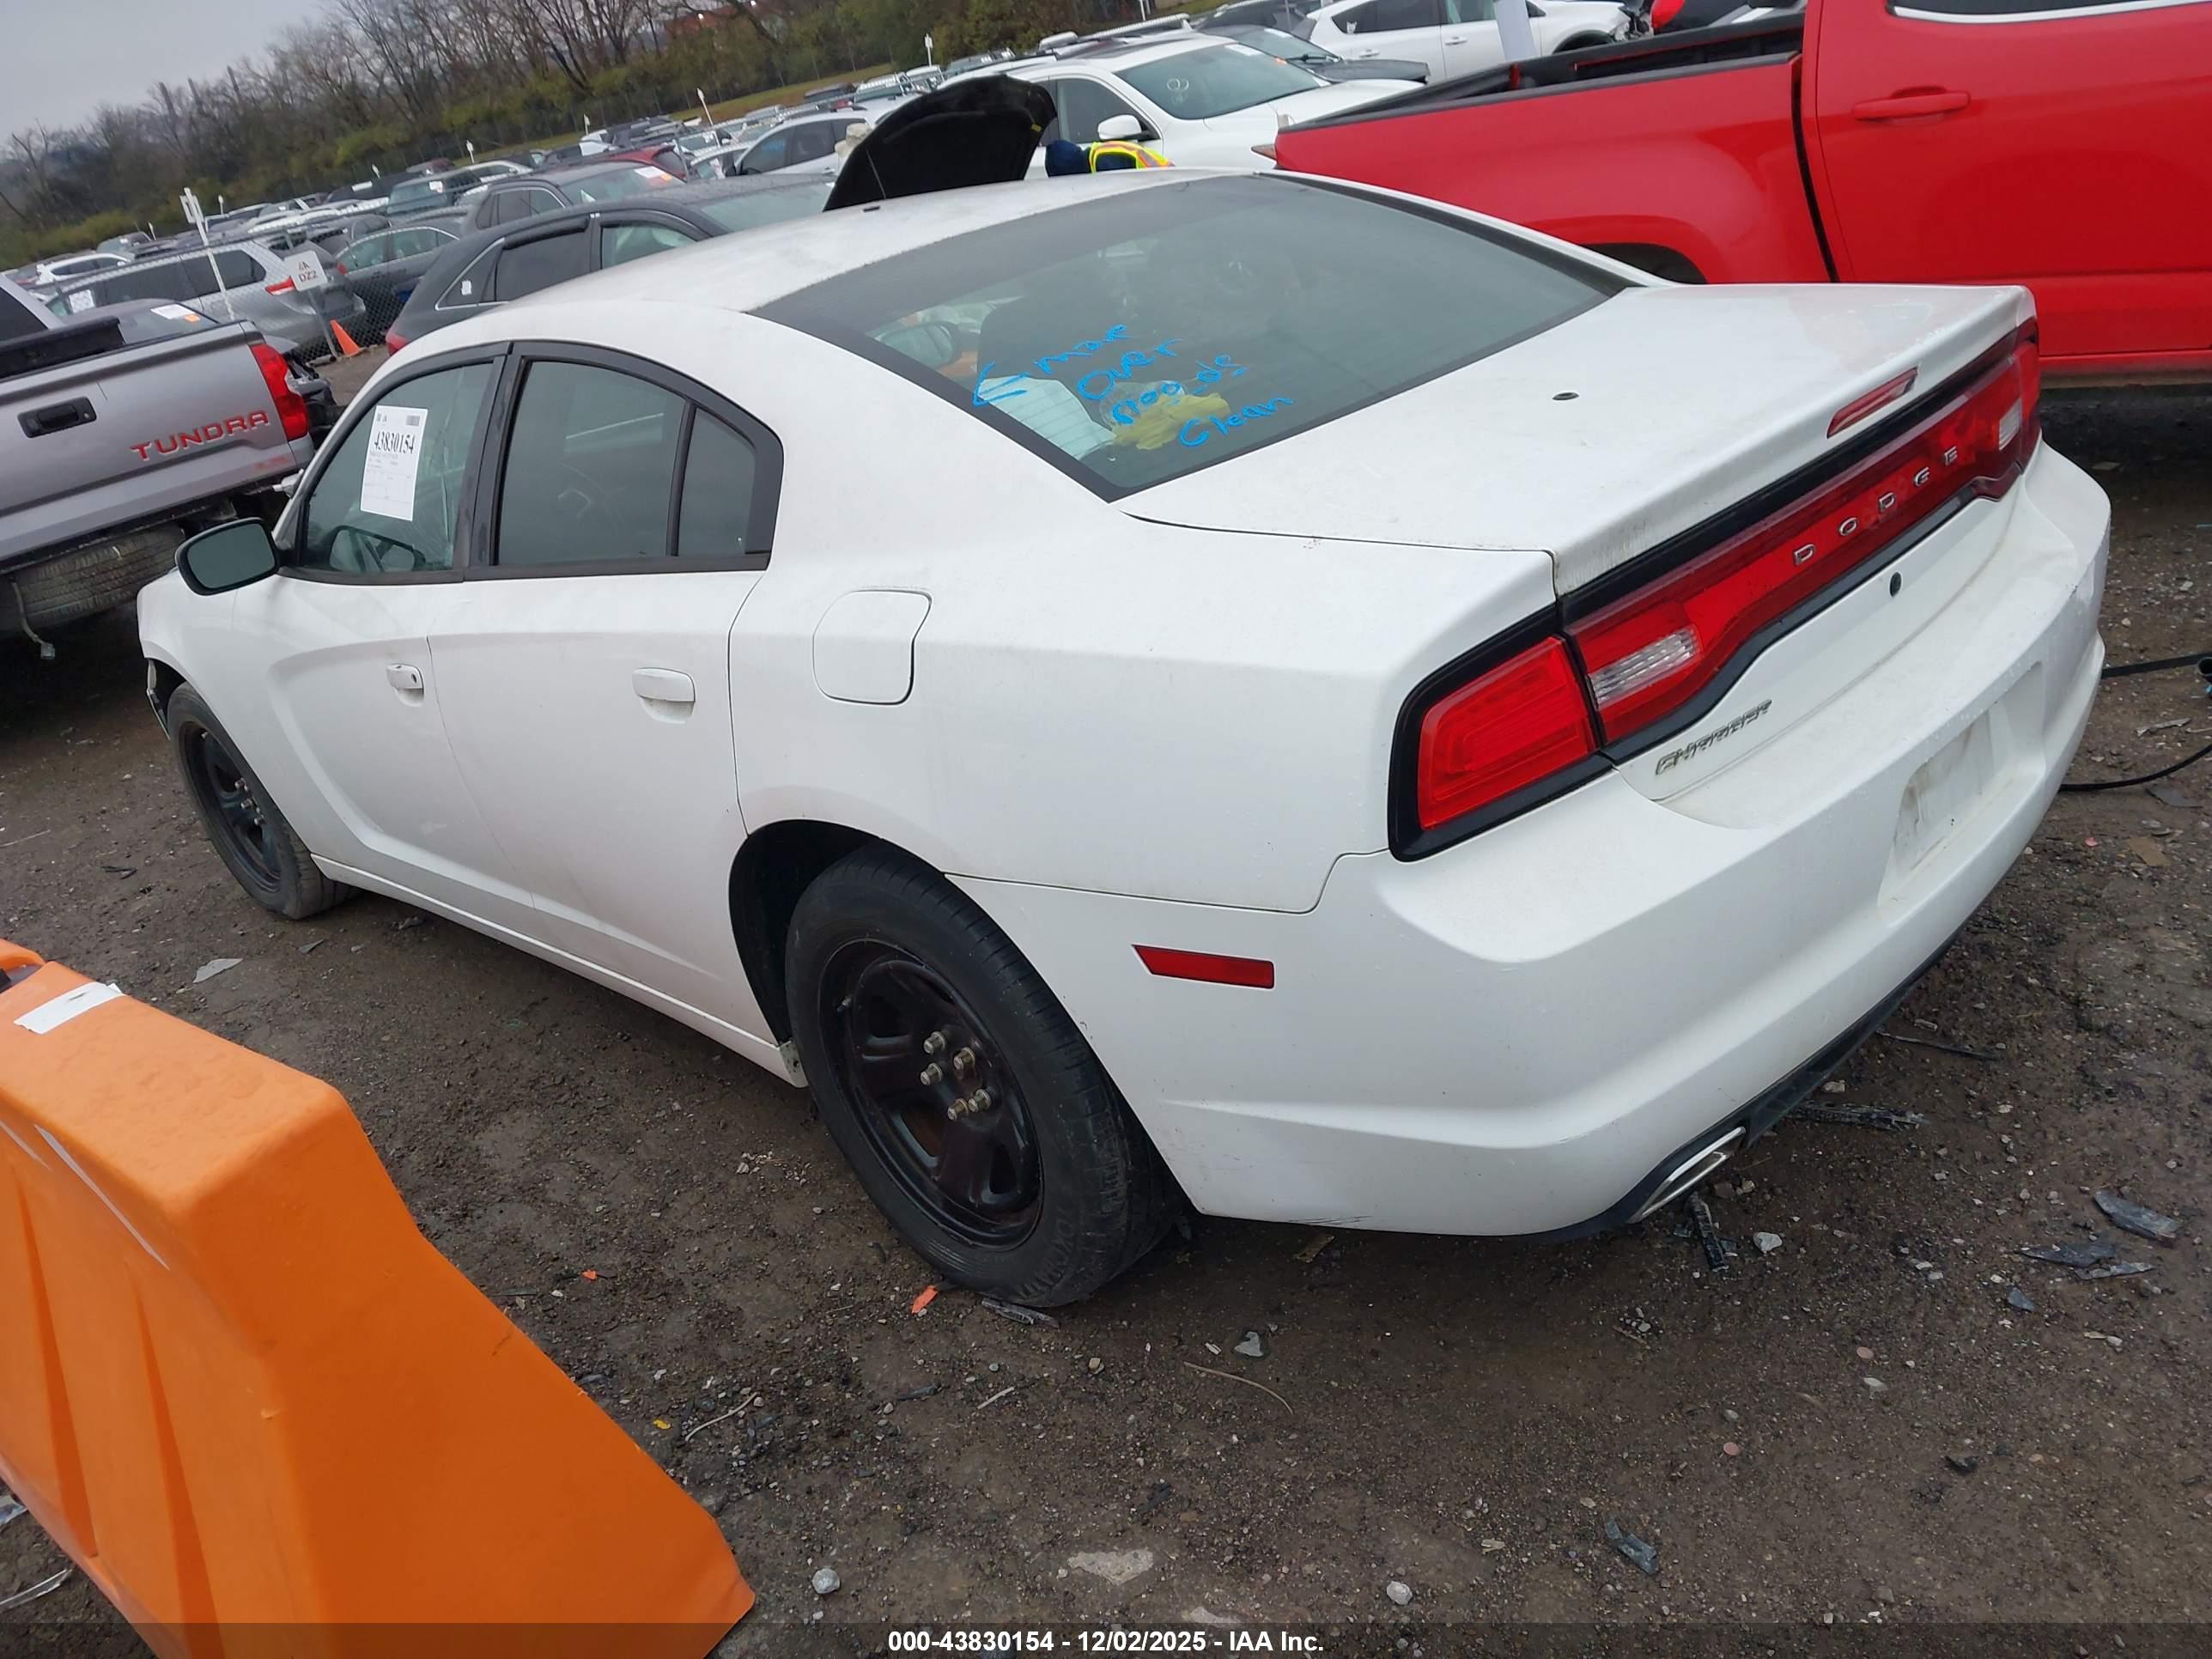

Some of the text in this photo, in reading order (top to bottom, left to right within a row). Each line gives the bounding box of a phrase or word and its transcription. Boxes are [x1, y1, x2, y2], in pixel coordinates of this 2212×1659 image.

[130, 410, 270, 461] TUNDRA
[374, 430, 416, 454] 43830154
[1179, 394, 1294, 447] Clean
[1793, 446, 1958, 566] DODGE
